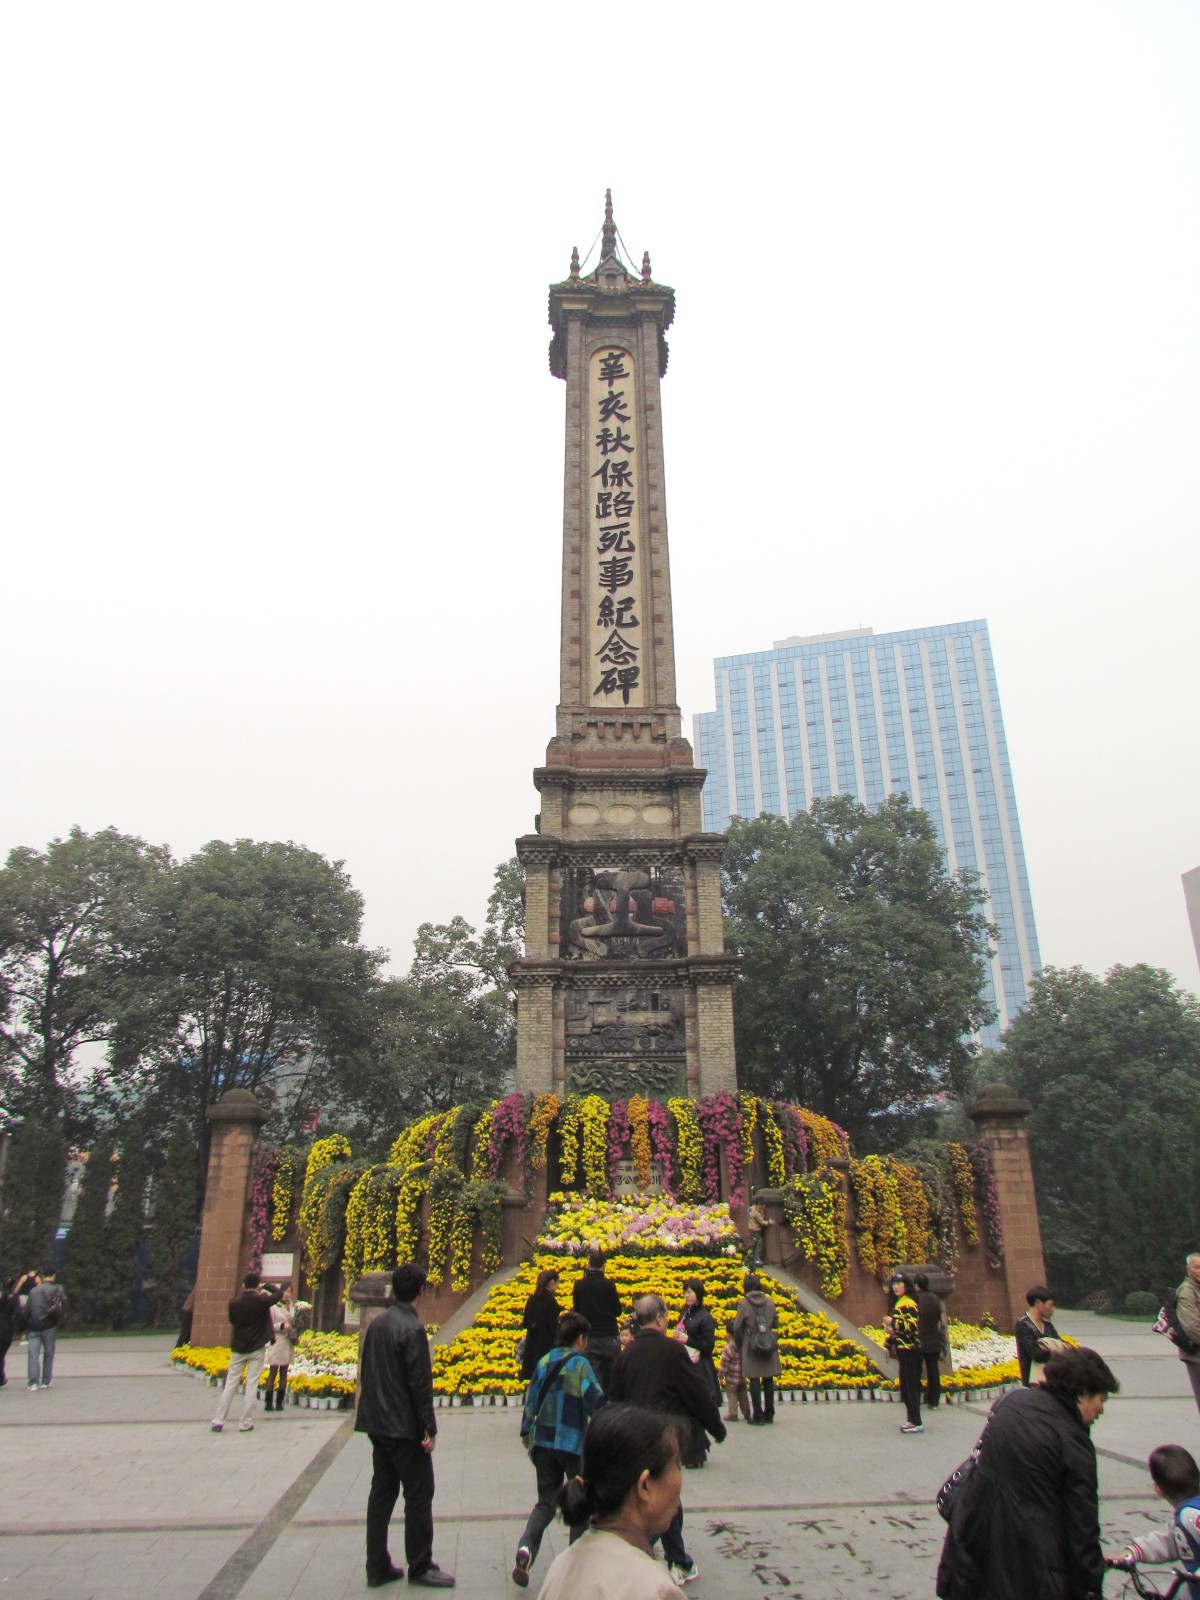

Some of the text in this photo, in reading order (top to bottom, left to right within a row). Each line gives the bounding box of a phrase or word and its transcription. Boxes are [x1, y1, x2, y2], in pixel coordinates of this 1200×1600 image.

[592, 352, 640, 704] 辛亥秋保路死事紀念碑
